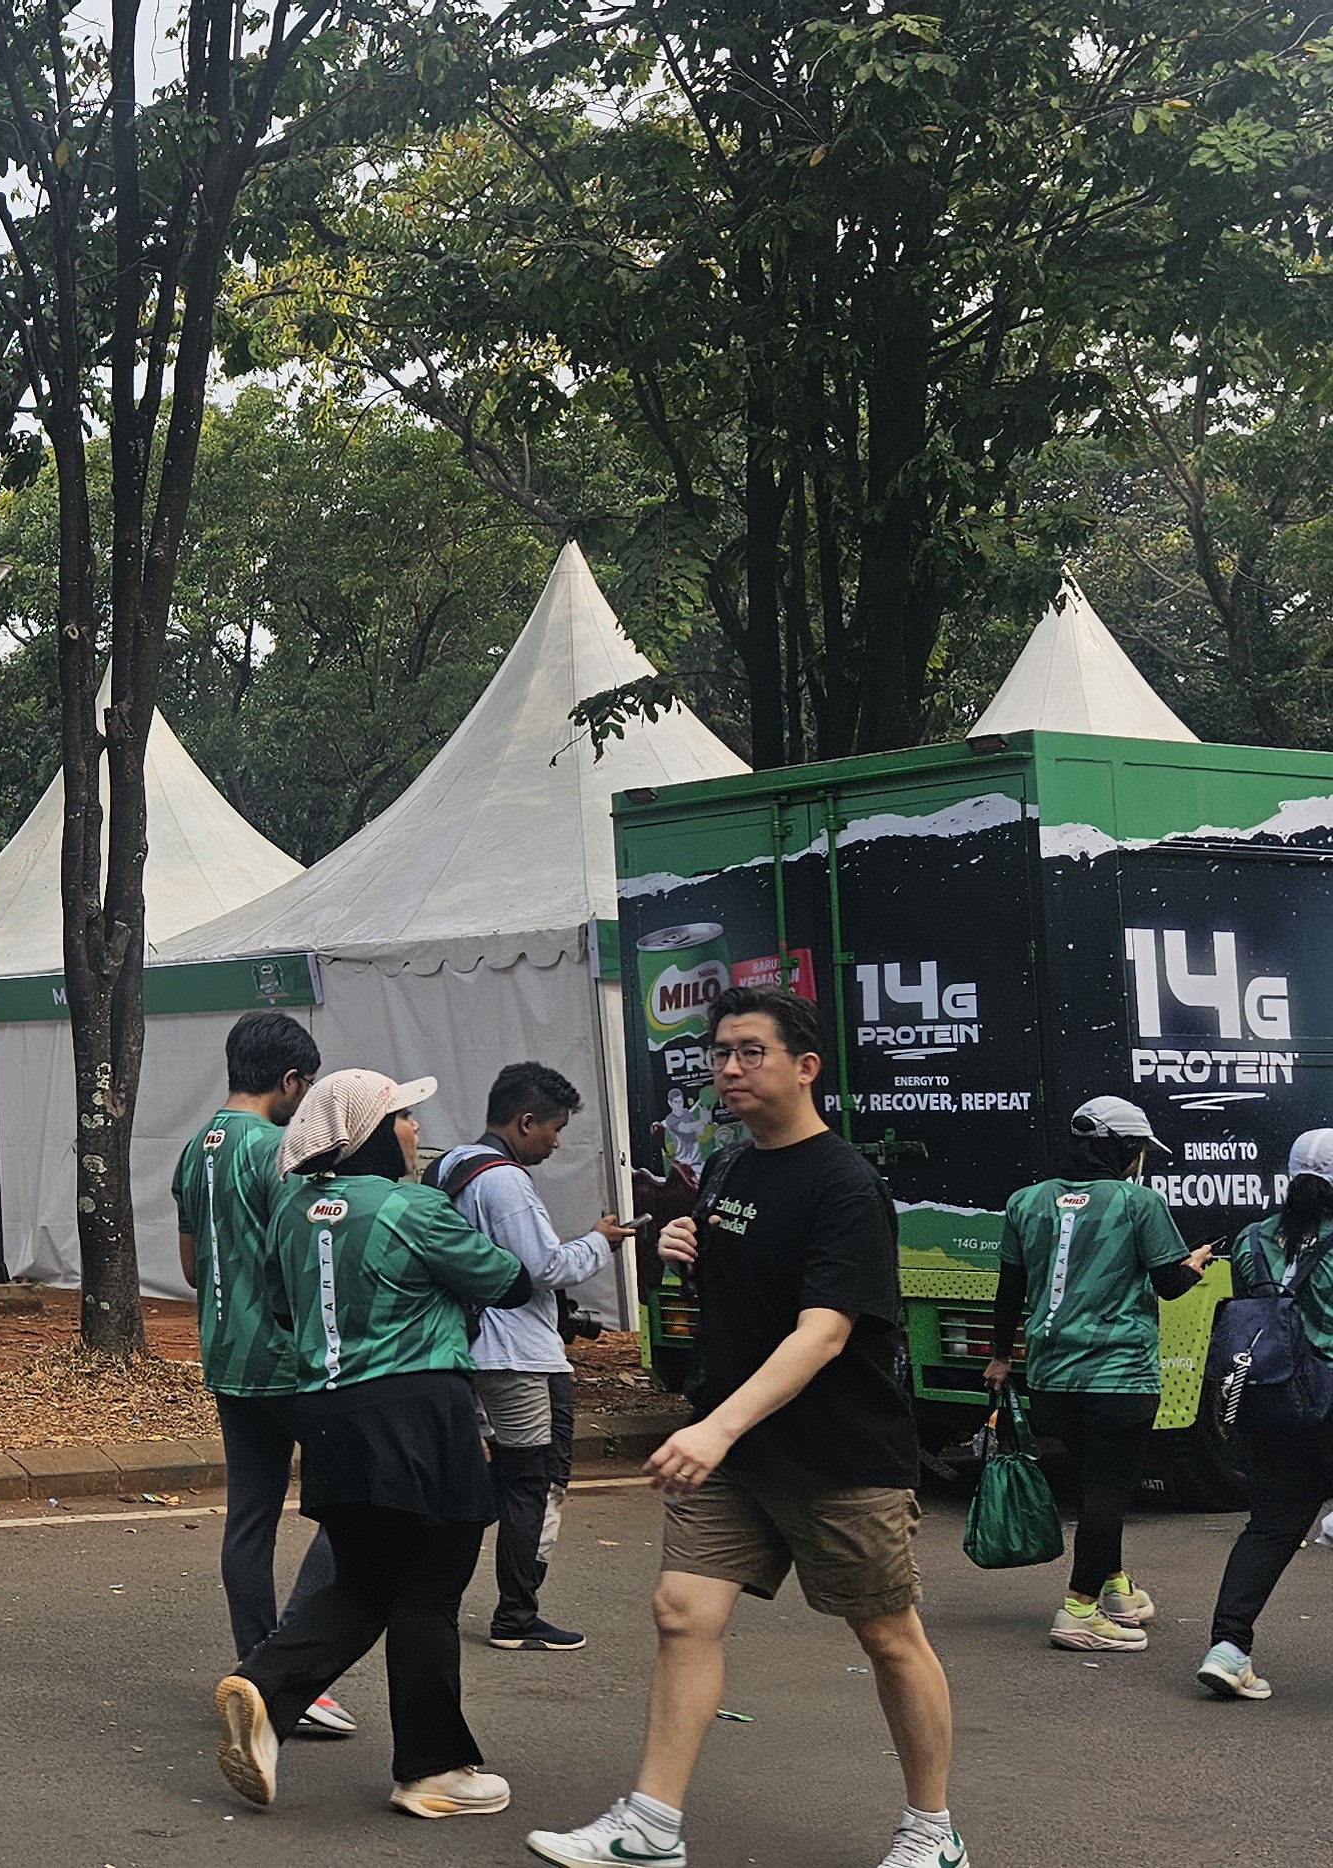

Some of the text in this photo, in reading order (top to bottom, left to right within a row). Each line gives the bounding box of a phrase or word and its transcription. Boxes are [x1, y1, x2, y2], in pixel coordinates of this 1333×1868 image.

[739, 968, 800, 987] KEMASN
[659, 977, 721, 1012] MILO
[894, 1076, 949, 1086] ENERGY TO
[824, 1092, 1031, 1113] PLY, RECOVER, REPEAT
[1184, 1142, 1258, 1161] ENERGY TO
[1062, 1197, 1086, 1205] MILO
[1150, 1174, 1269, 1210] RECOVER,
[313, 1205, 342, 1216] MILO
[743, 1203, 757, 1219] de
[719, 1218, 748, 1235] adel
[321, 1237, 338, 1373] JAKARTA
[1161, 1358, 1192, 1371] erving
